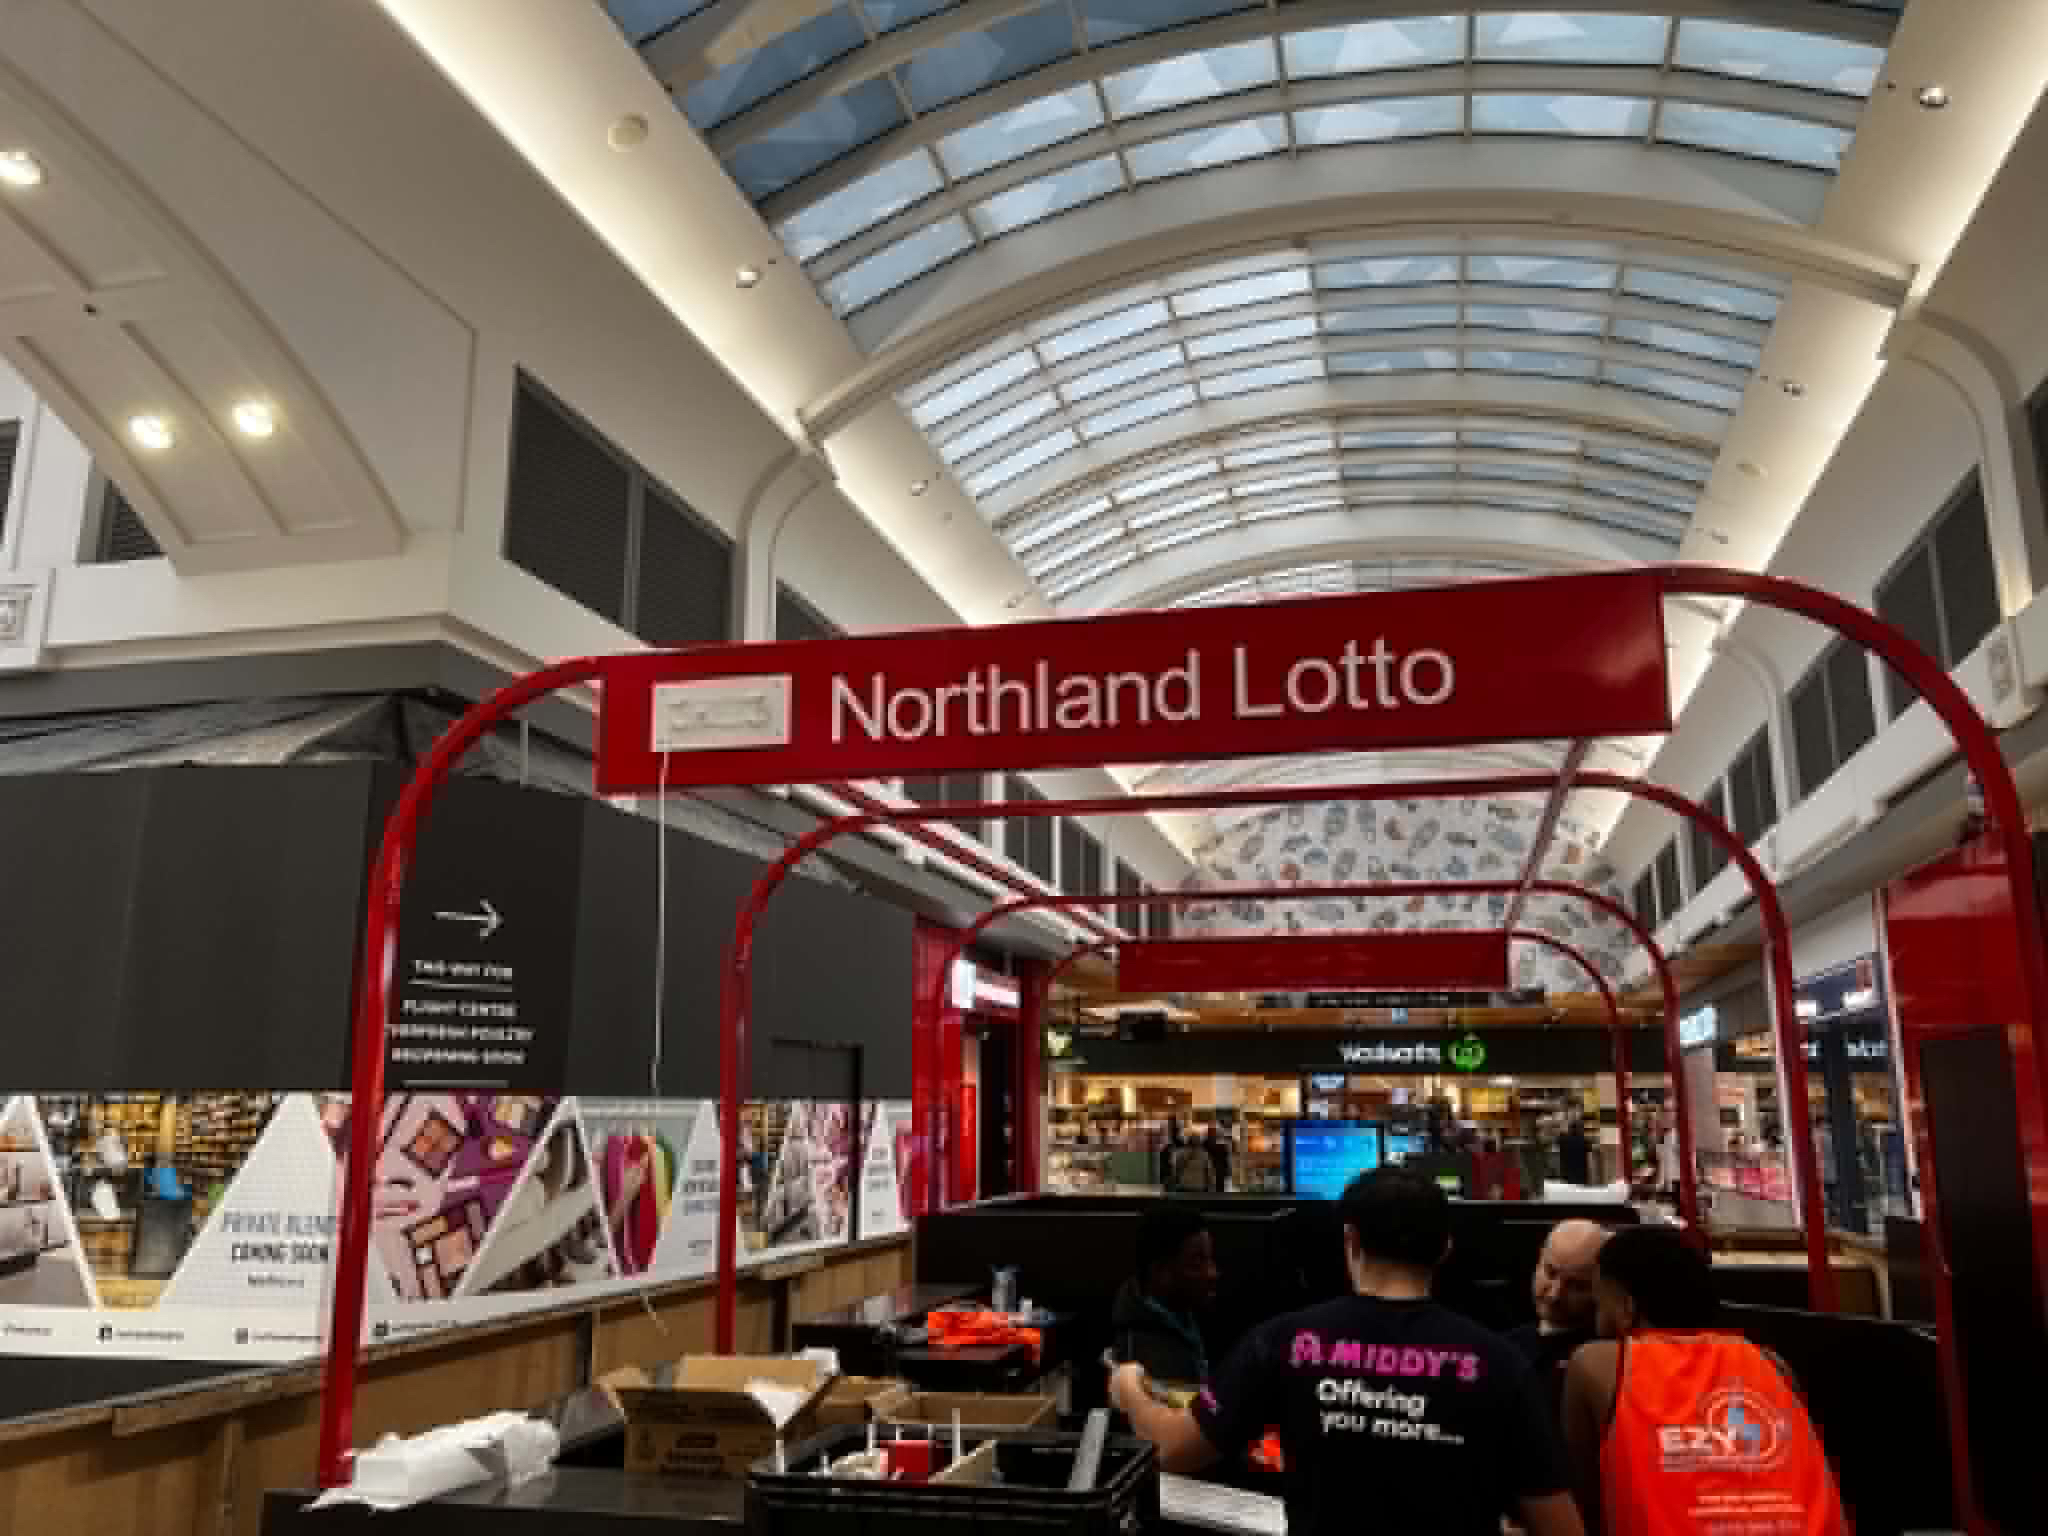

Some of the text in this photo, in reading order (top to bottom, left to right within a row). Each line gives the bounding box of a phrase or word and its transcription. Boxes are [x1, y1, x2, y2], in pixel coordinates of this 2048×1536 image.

[831, 637, 1455, 742] Northland Lotto
[1330, 1340, 1480, 1382] MIDDY'S
[1316, 1377, 1427, 1419] Offering
[1319, 1411, 1367, 1436] you
